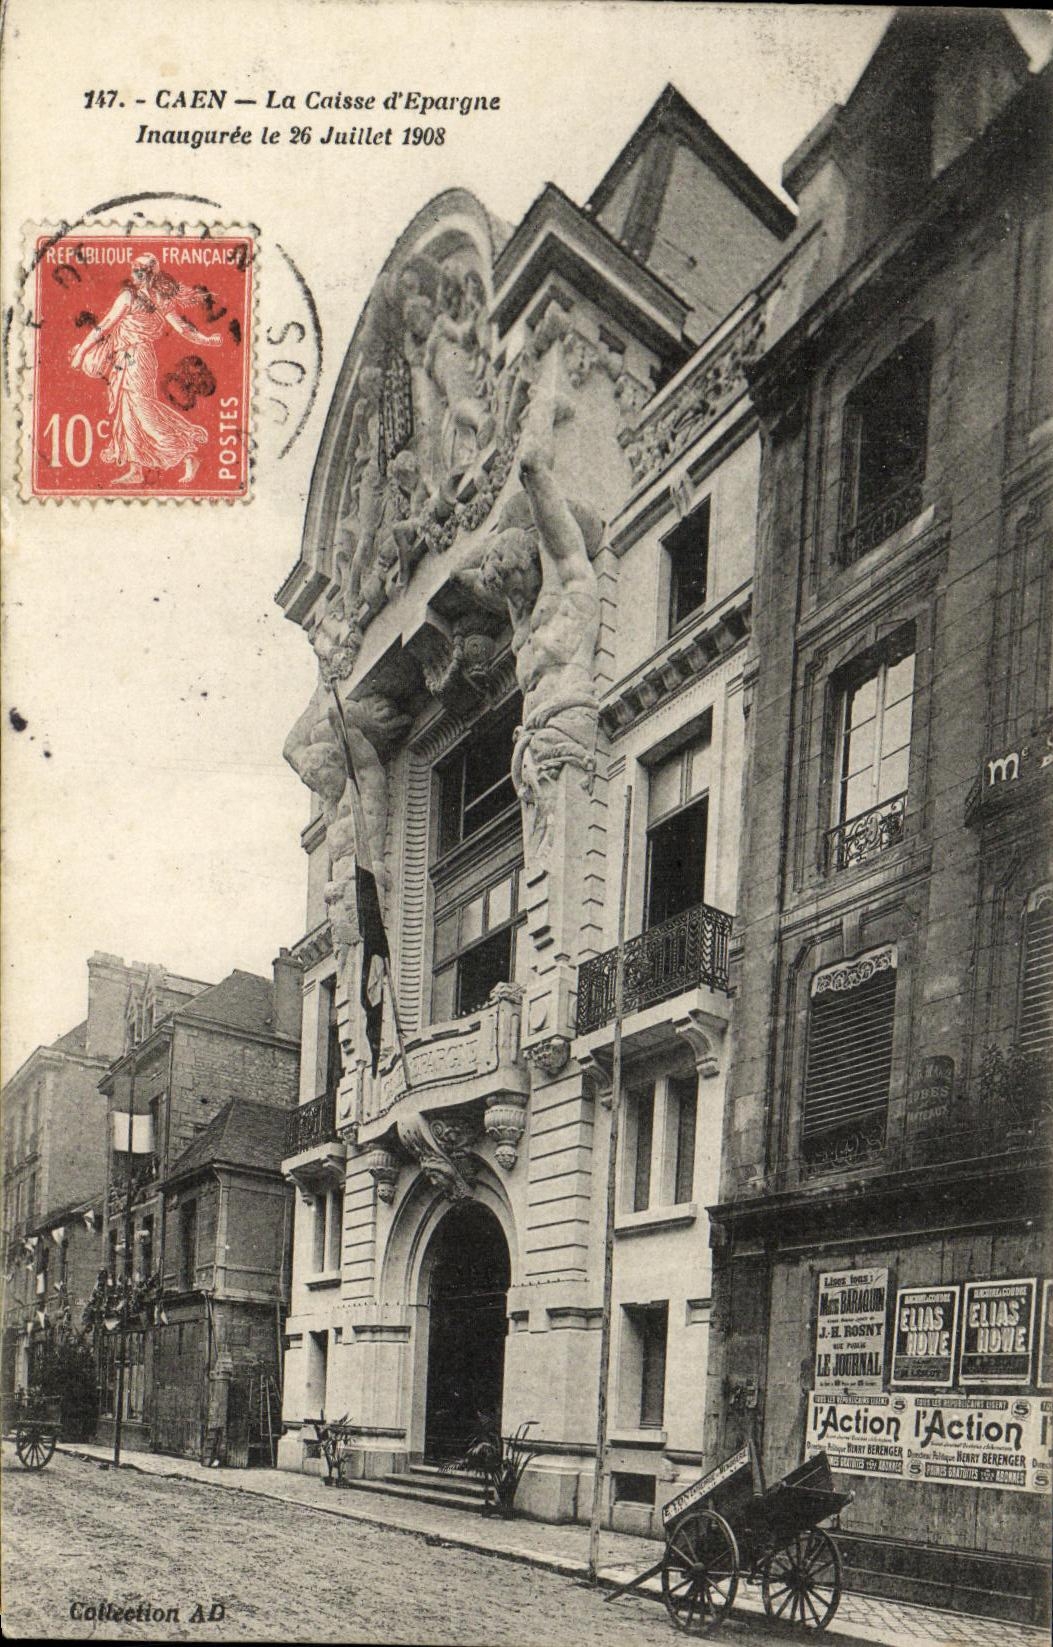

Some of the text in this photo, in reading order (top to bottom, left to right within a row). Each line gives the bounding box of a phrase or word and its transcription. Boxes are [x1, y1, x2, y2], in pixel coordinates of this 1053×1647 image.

[218, 396, 239, 480] POSTES
[900, 1306, 944, 1332] ELIAS
[969, 1300, 1020, 1328] ELIAS
[844, 1322, 883, 1337] ROSNY
[976, 1326, 1027, 1353] HOWE
[906, 1330, 950, 1356] HOWE
[817, 1353, 831, 1377] LE
[833, 1352, 882, 1376] JOURNAL
[915, 1410, 1022, 1451] l'Action
